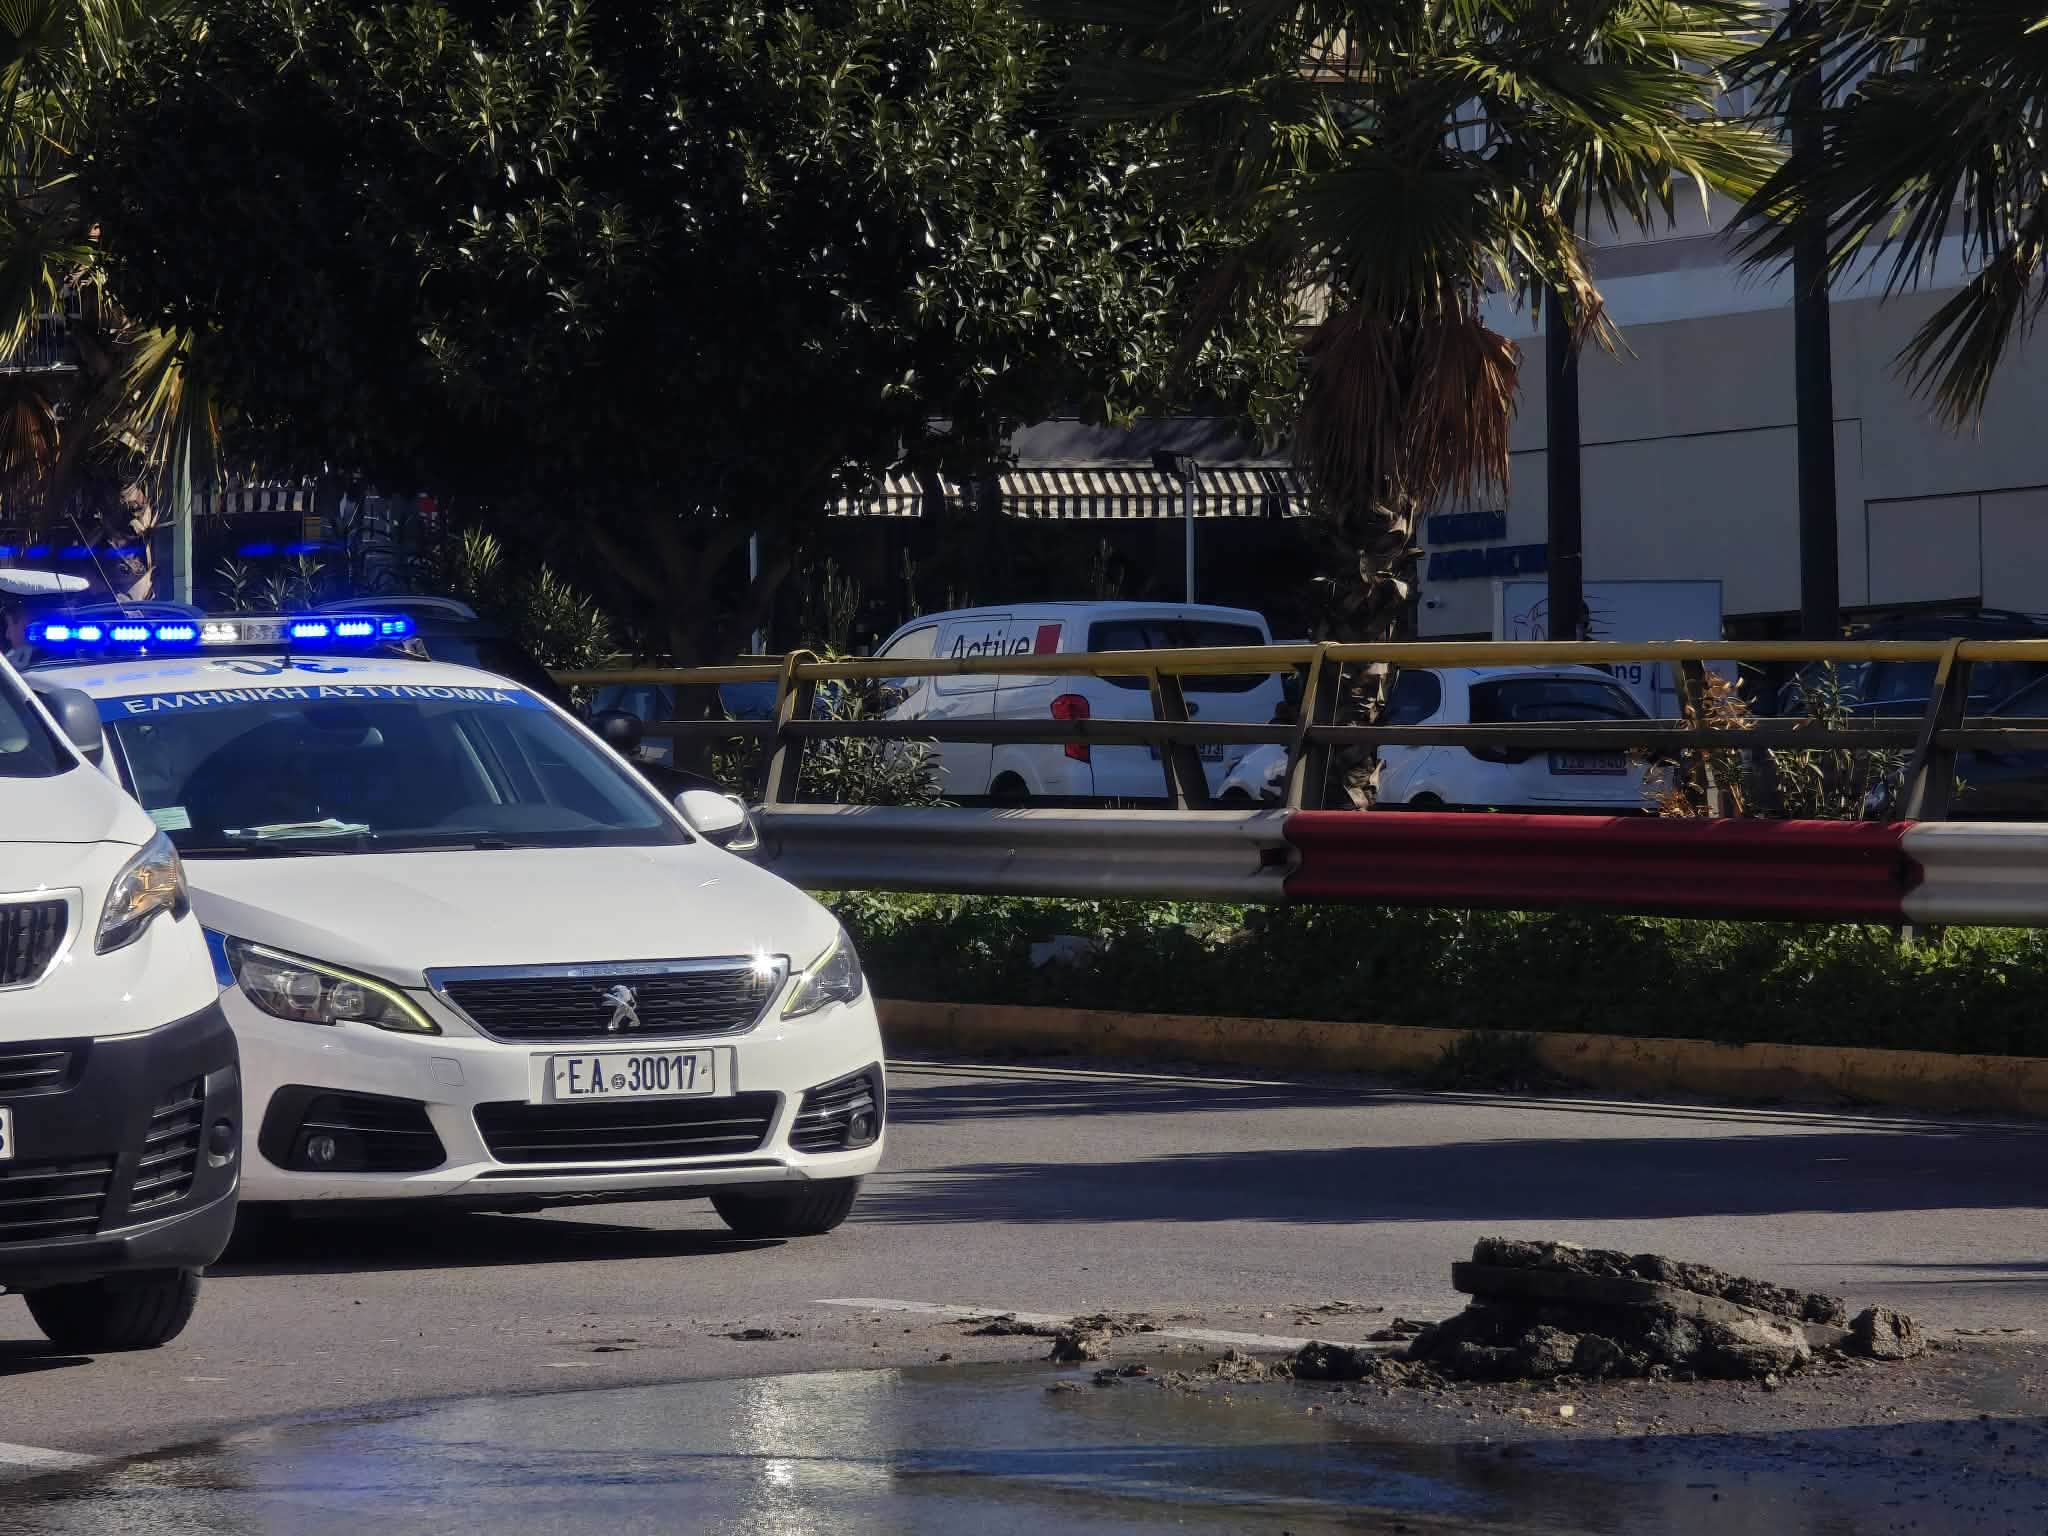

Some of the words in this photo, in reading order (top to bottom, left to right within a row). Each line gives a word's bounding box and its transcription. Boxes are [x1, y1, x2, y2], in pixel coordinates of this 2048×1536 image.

[951, 630, 1031, 659] Active
[122, 686, 306, 713] ΕΛΛΗΝΙΚΗ
[320, 685, 518, 707] ΑΣΤΥΝΟΜΙΑ
[627, 1055, 697, 1091] 30017
